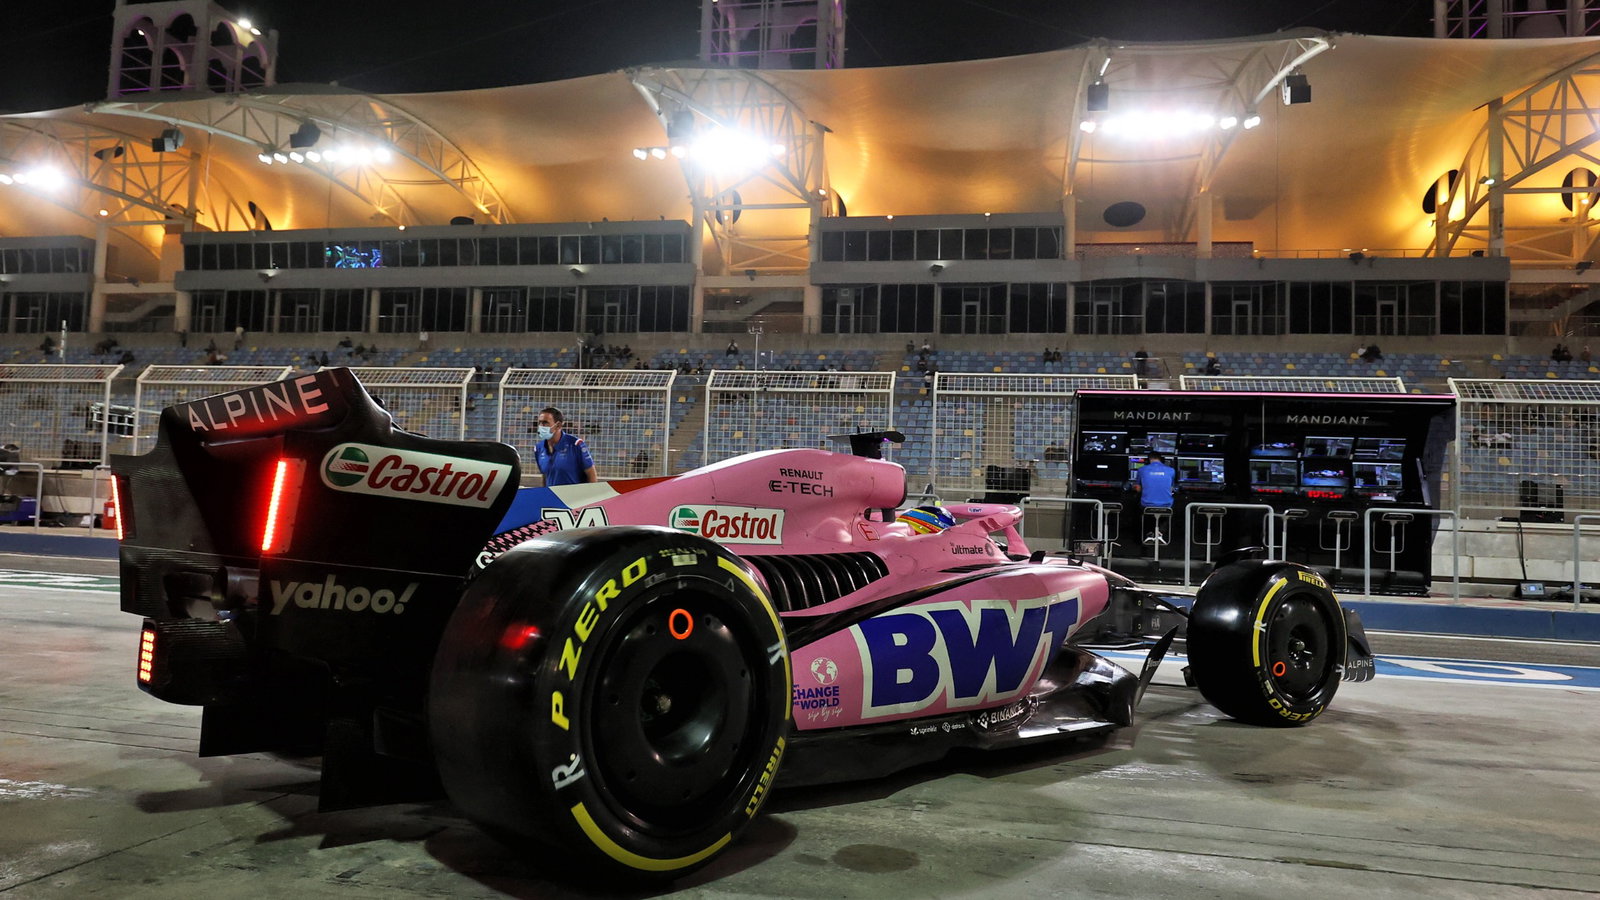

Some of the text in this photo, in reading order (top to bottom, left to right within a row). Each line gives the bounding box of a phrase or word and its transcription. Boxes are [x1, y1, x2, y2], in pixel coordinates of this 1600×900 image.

[187, 375, 330, 433] ALPINE
[1113, 411, 1192, 421] MANDIANT
[1286, 415, 1370, 425] MANDIANT
[367, 454, 499, 502] Castrol
[779, 468, 824, 481] RENAULT
[768, 479, 834, 498] E-TECH
[701, 509, 778, 540] Castrol
[951, 545, 984, 555] ultimate
[1297, 570, 1327, 589] PIRELLI
[269, 574, 420, 616] yahoo!
[551, 556, 648, 731] P ZERO
[855, 594, 1082, 710] BWT
[1347, 658, 1374, 670] ALPINE
[800, 698, 840, 710] WORLD
[1268, 698, 1312, 721] ZERO
[745, 735, 787, 820] PIRELLI
